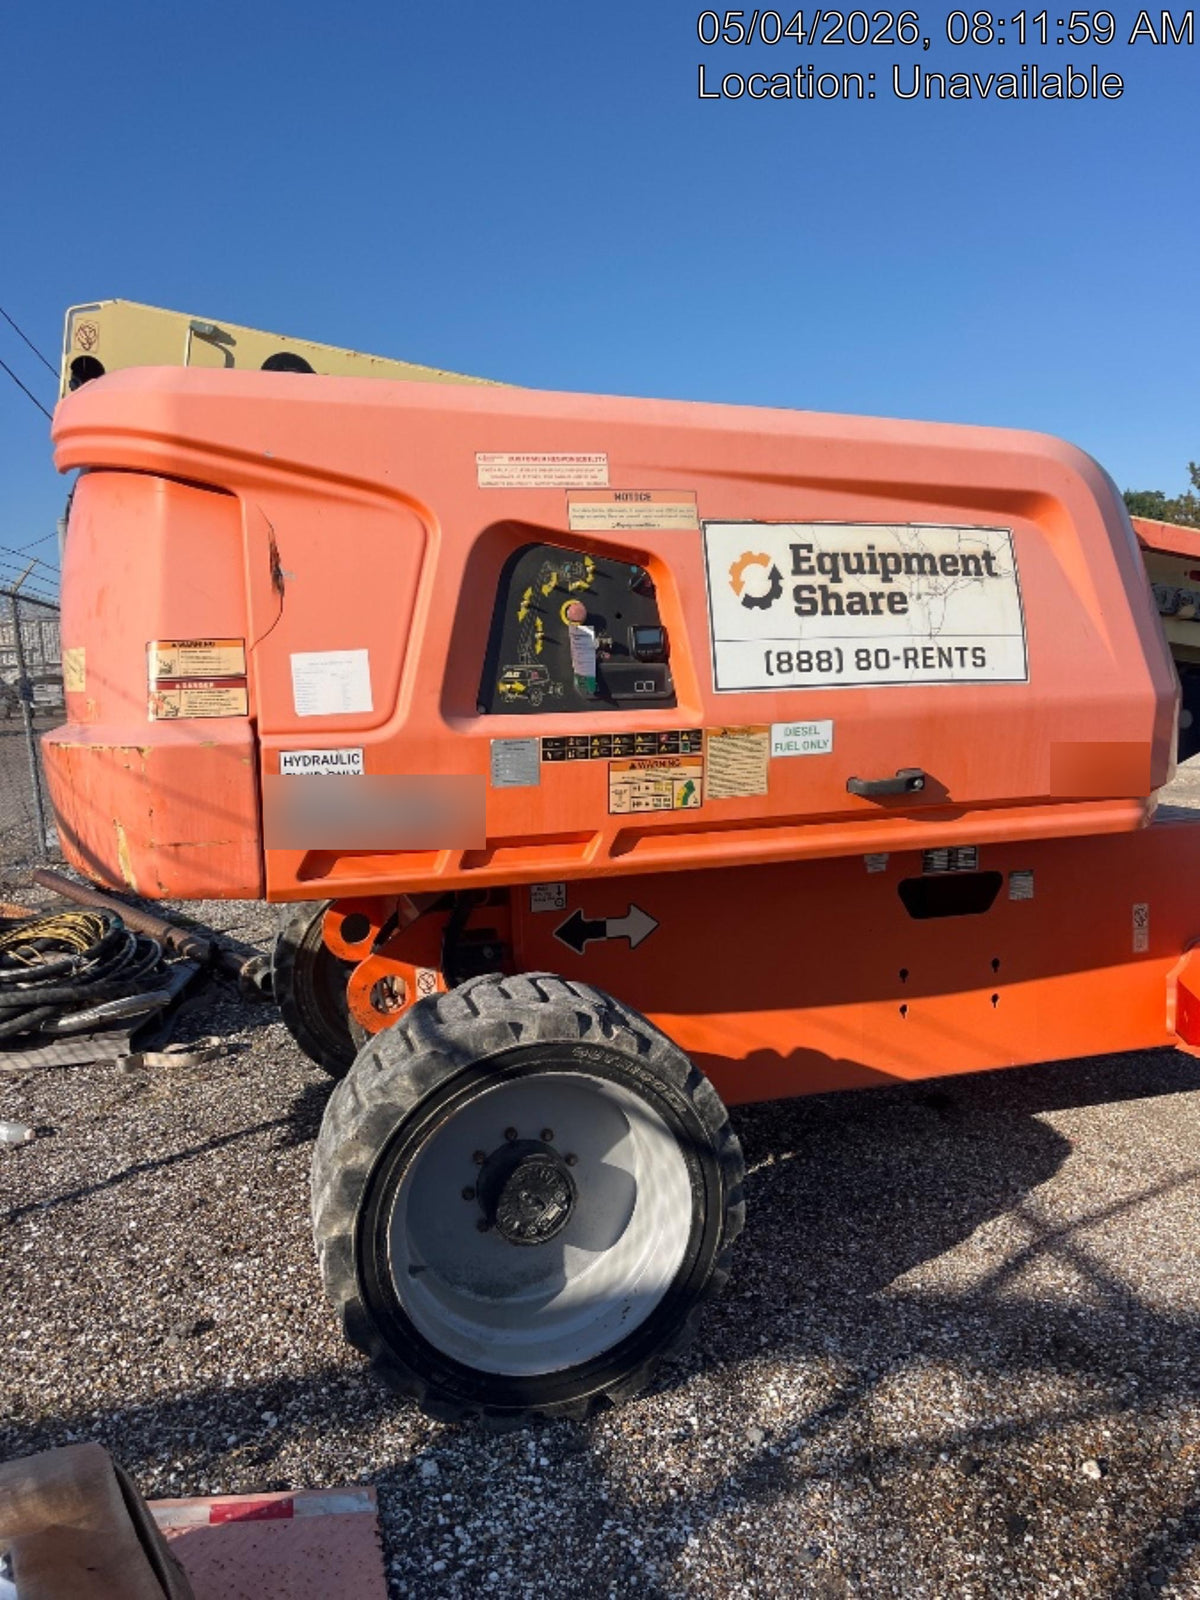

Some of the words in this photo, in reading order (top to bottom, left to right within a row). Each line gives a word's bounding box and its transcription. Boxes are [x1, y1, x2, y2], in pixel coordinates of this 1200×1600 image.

[614, 491, 652, 502] NOTICE
[788, 543, 999, 583] Equipment
[792, 584, 910, 617] Share
[764, 647, 844, 677] (888)
[854, 646, 987, 671] 80-RENTS
[783, 725, 820, 737] DIESEL
[774, 741, 800, 753] FUEL
[801, 739, 830, 751] ONLY
[283, 753, 360, 767] HYDRAULIC
[637, 758, 681, 770] WARNING
